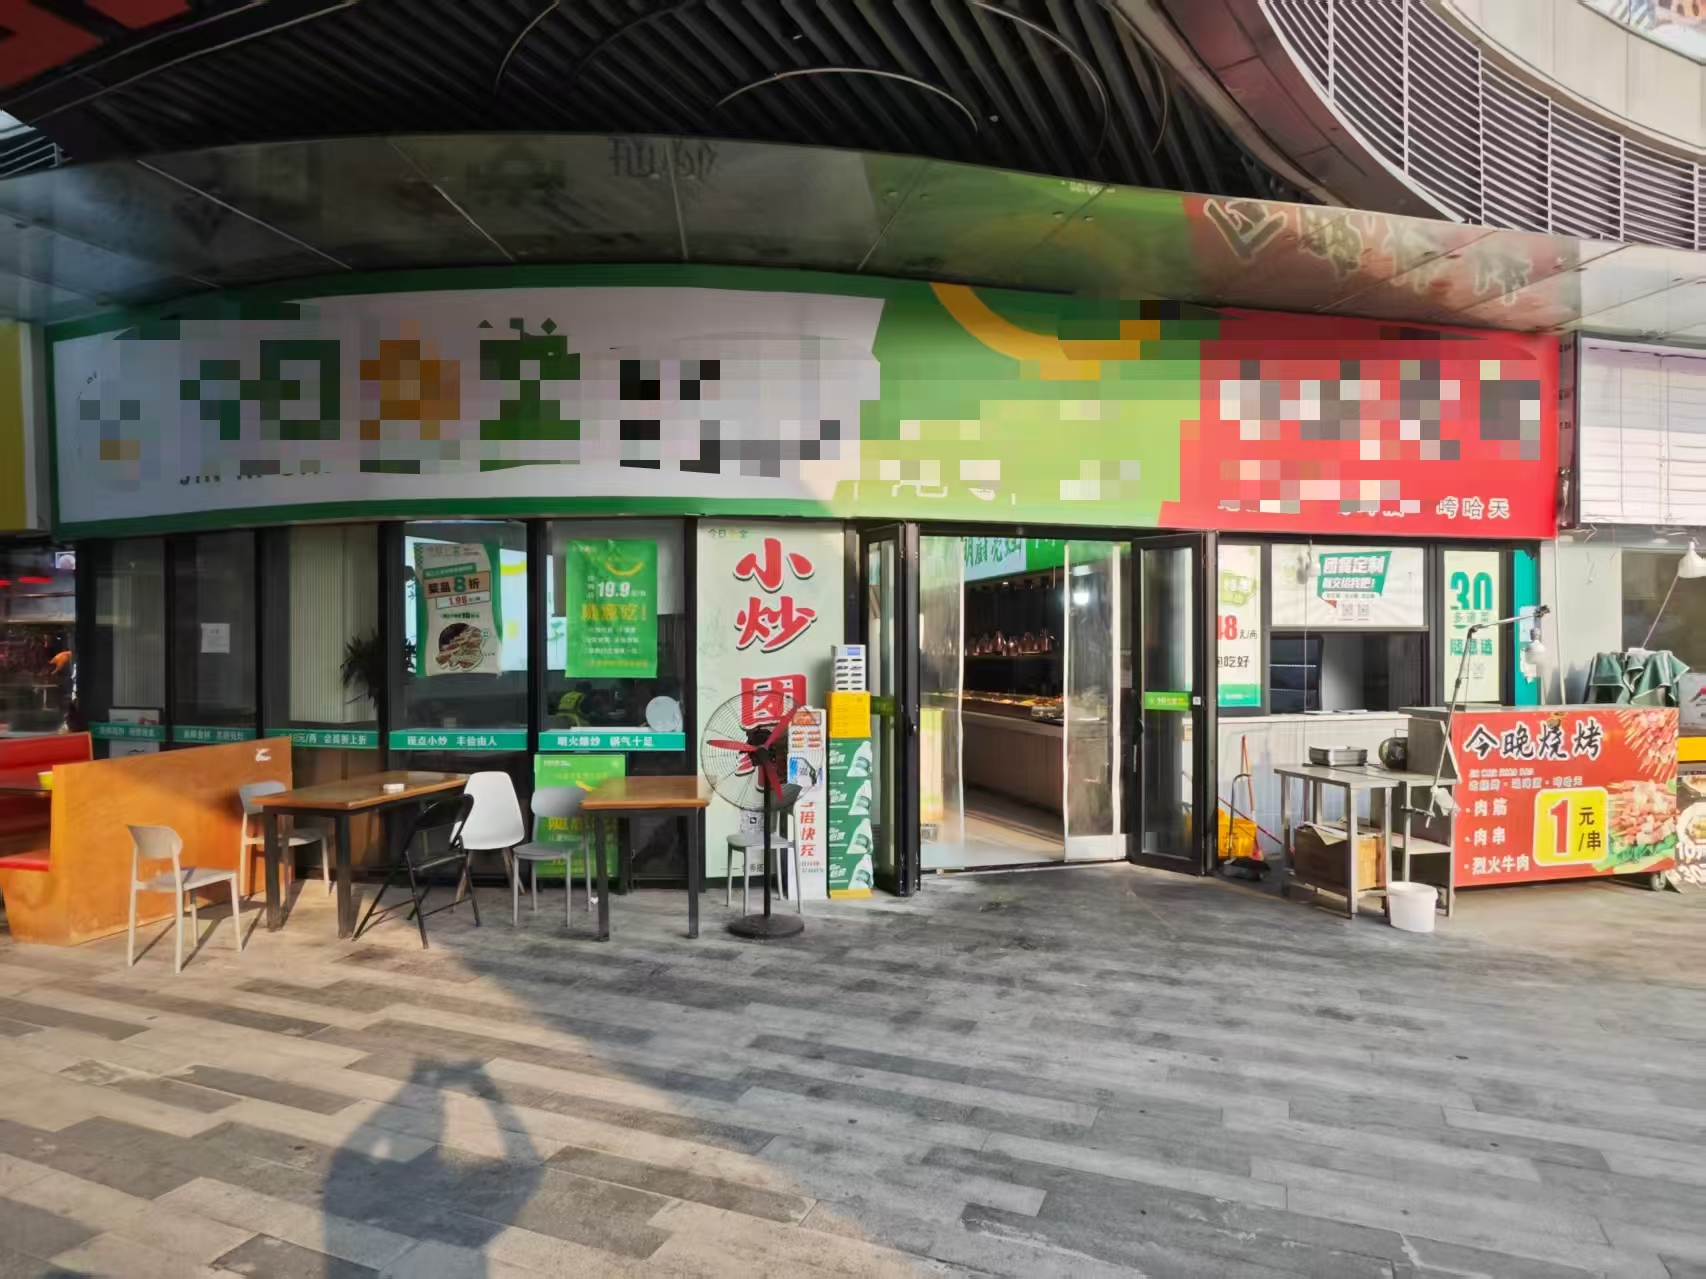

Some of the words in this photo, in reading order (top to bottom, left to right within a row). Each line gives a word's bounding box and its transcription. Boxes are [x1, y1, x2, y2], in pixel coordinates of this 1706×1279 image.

[1450, 571, 1493, 628] 30
[1463, 716, 1604, 761] 今晚烧烤
[800, 802, 816, 857] 倍快充
[1548, 797, 1571, 856] 1
[1578, 806, 1596, 826] 元
[1473, 826, 1506, 846] 肉串
[1578, 829, 1602, 852] /串
[1472, 853, 1530, 875] 烈火牛肉
